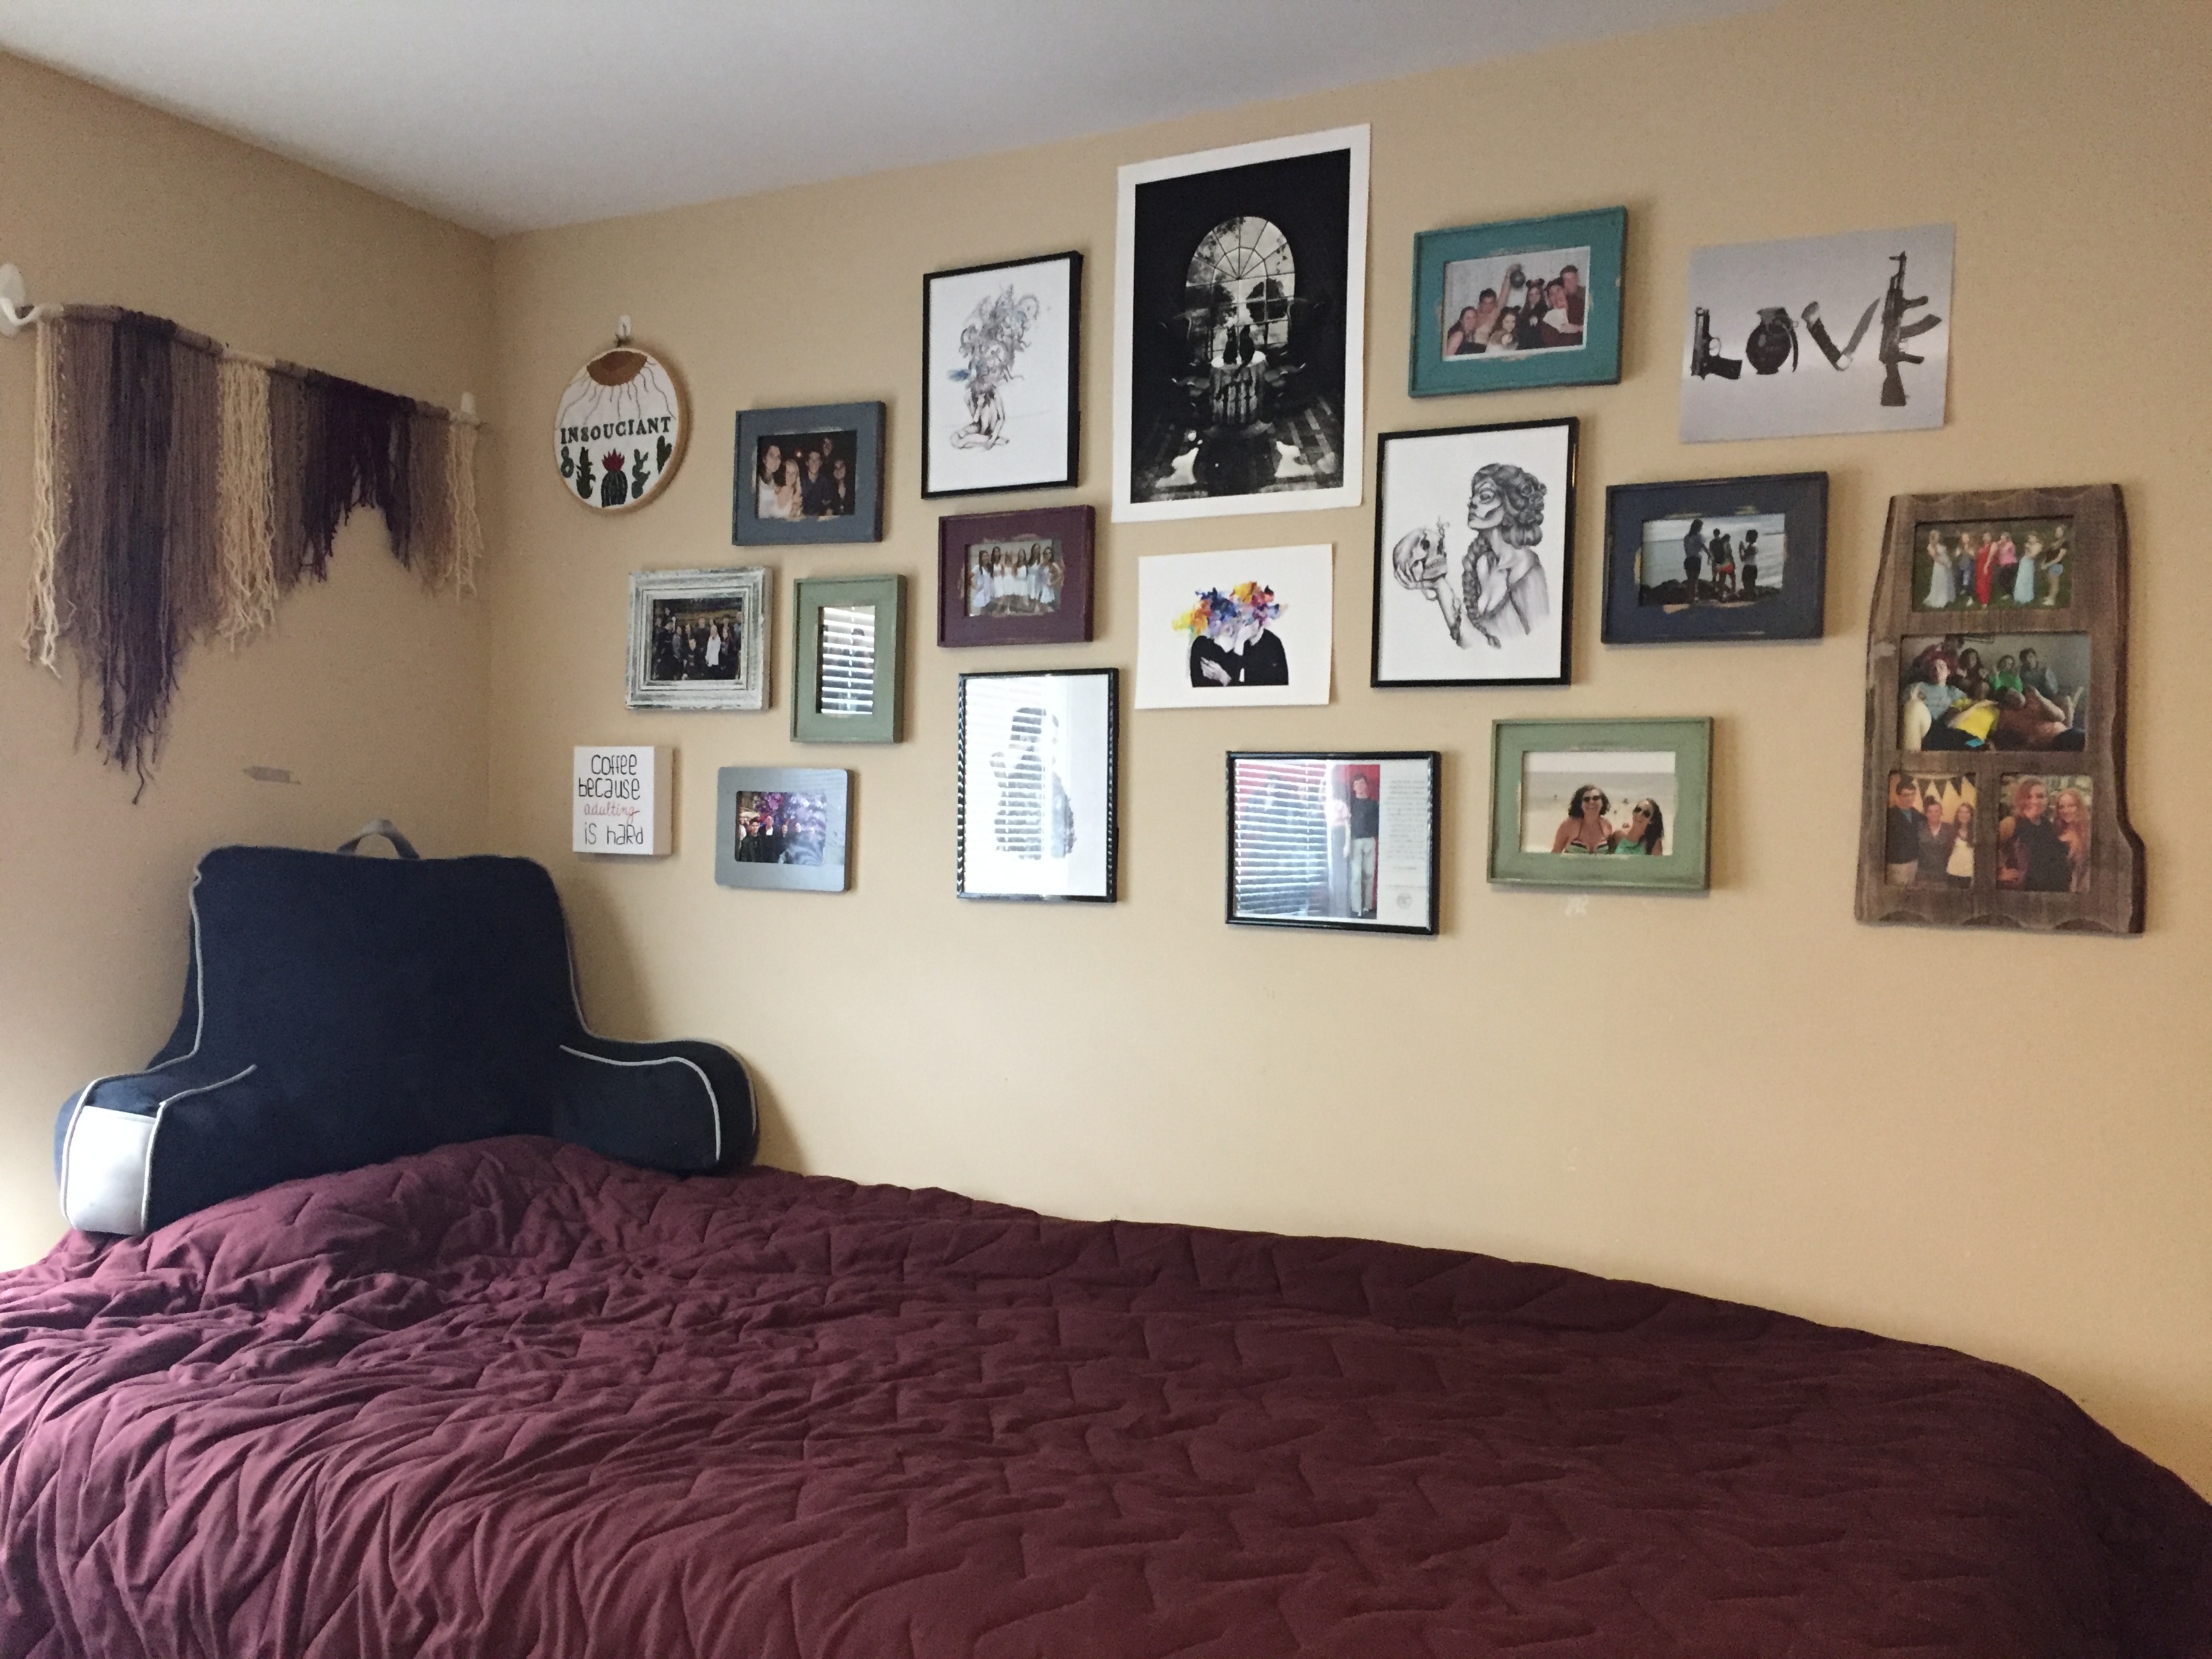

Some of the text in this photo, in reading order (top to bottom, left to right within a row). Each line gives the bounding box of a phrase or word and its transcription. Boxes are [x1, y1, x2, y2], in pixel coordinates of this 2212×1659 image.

[1691, 251, 1942, 407] LOVE
[560, 416, 671, 445] INSOUCIANT
[578, 777, 640, 800] because
[584, 802, 640, 824] adulting
[584, 822, 597, 844] is
